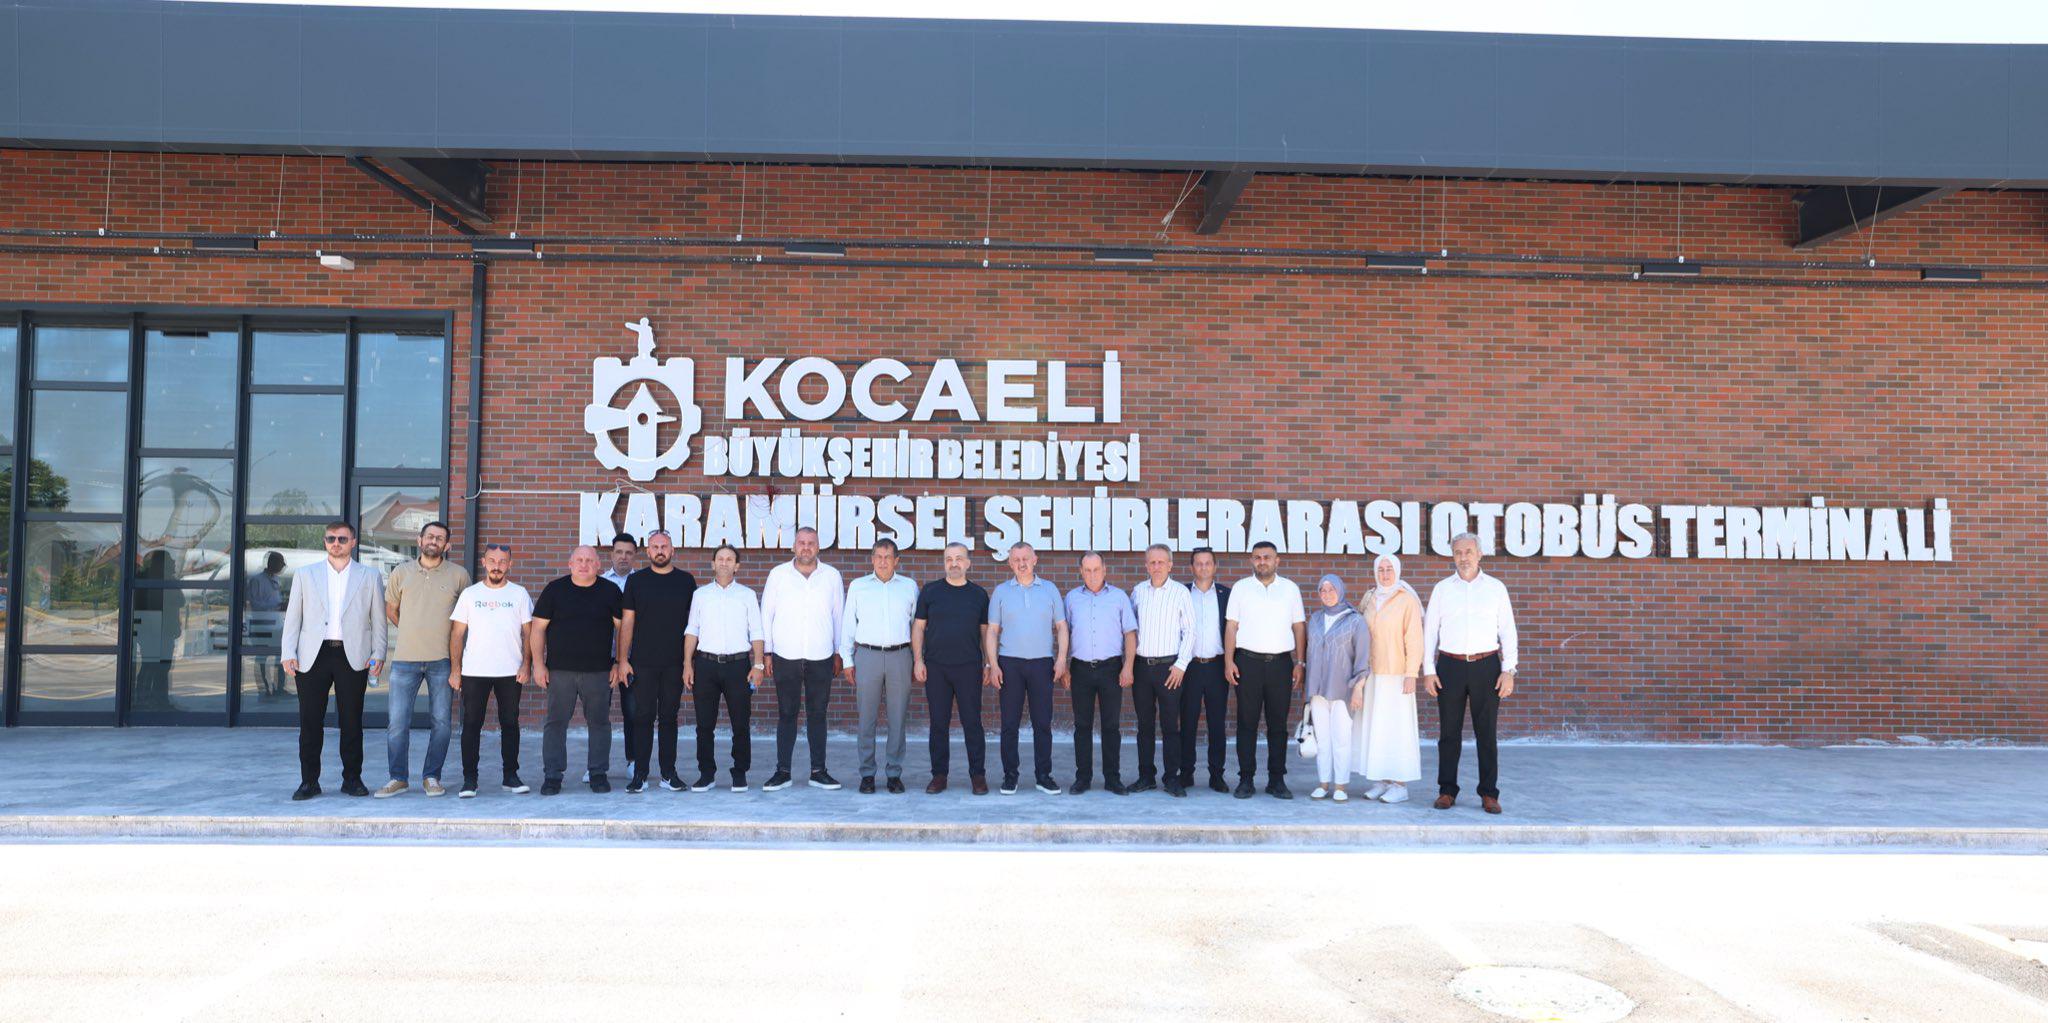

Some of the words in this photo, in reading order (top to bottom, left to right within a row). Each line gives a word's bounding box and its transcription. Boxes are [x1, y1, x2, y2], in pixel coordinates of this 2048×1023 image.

[725, 350, 1121, 423] KOCAELİ
[704, 427, 934, 485] BÜYÜKŞEHİR
[938, 431, 1140, 482] BELEDİYESİ
[579, 483, 975, 550] KARAMÜRSEL
[984, 486, 1420, 561] ŞEHİRLERARASI
[1430, 493, 1654, 558] OTOBÜS
[1661, 496, 1953, 562] TERMİNALİ
